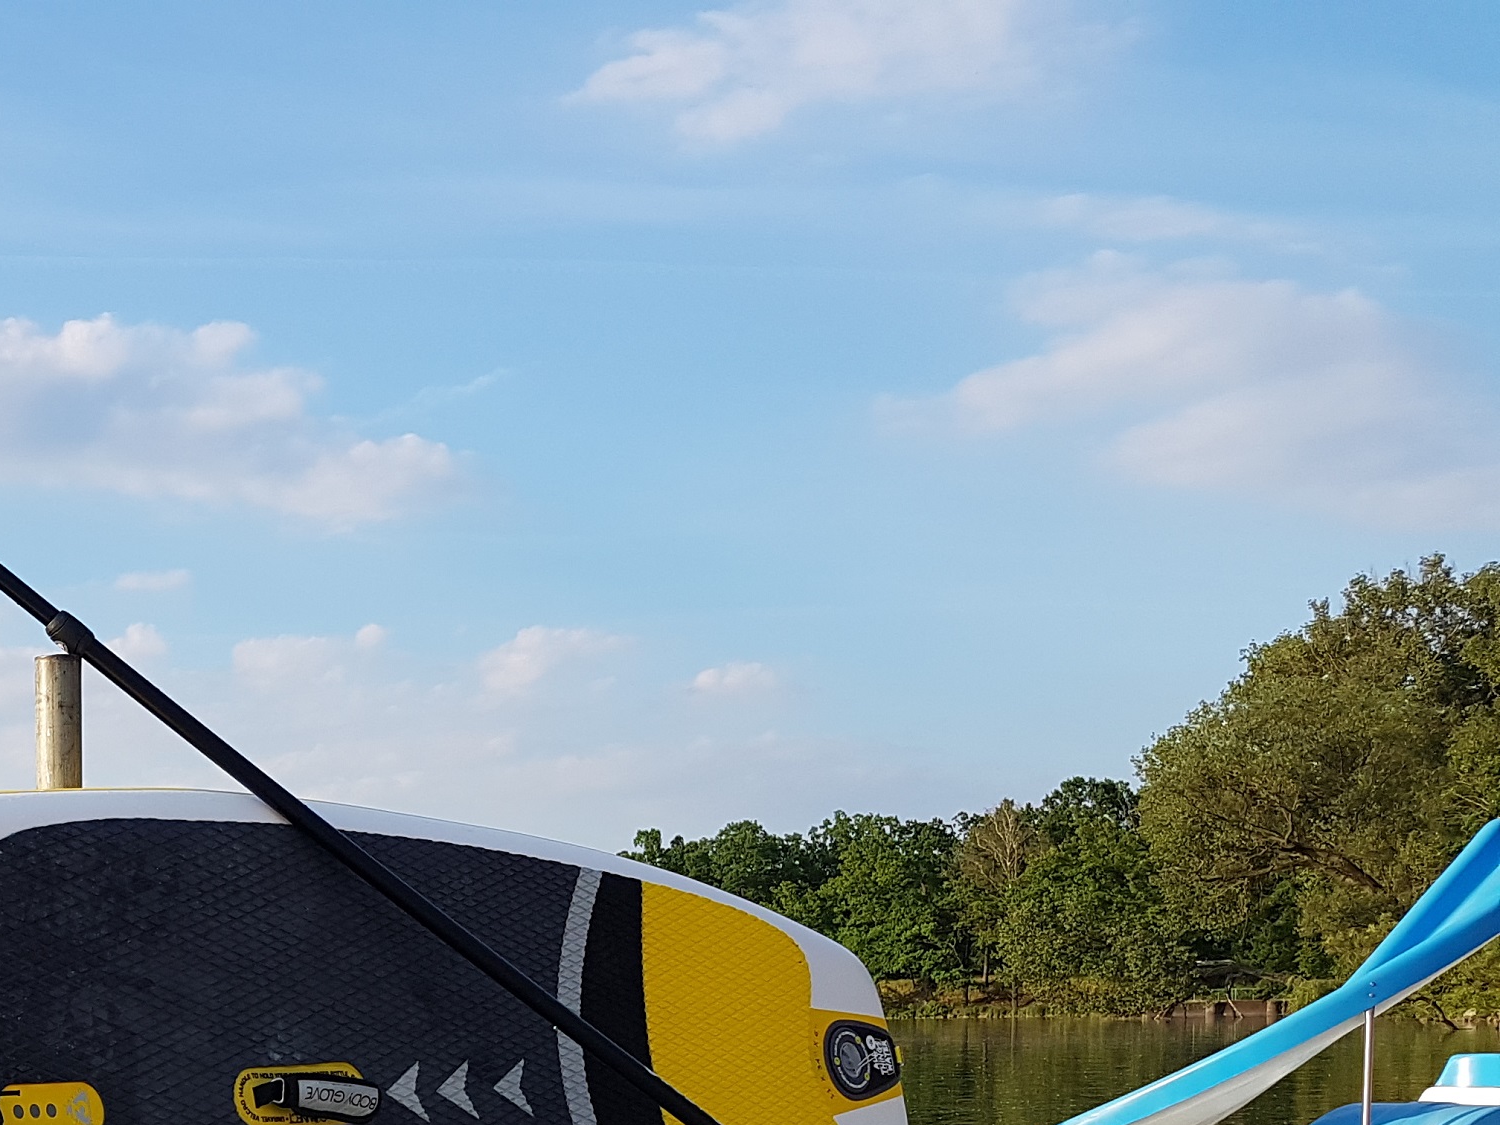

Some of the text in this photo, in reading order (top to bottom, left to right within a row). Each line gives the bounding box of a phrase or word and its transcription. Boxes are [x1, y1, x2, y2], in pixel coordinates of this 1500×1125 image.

[238, 1073, 251, 1098] HANDLE
[304, 1086, 377, 1110] BODY GLOVE
[240, 1100, 260, 1122] VELCRO
